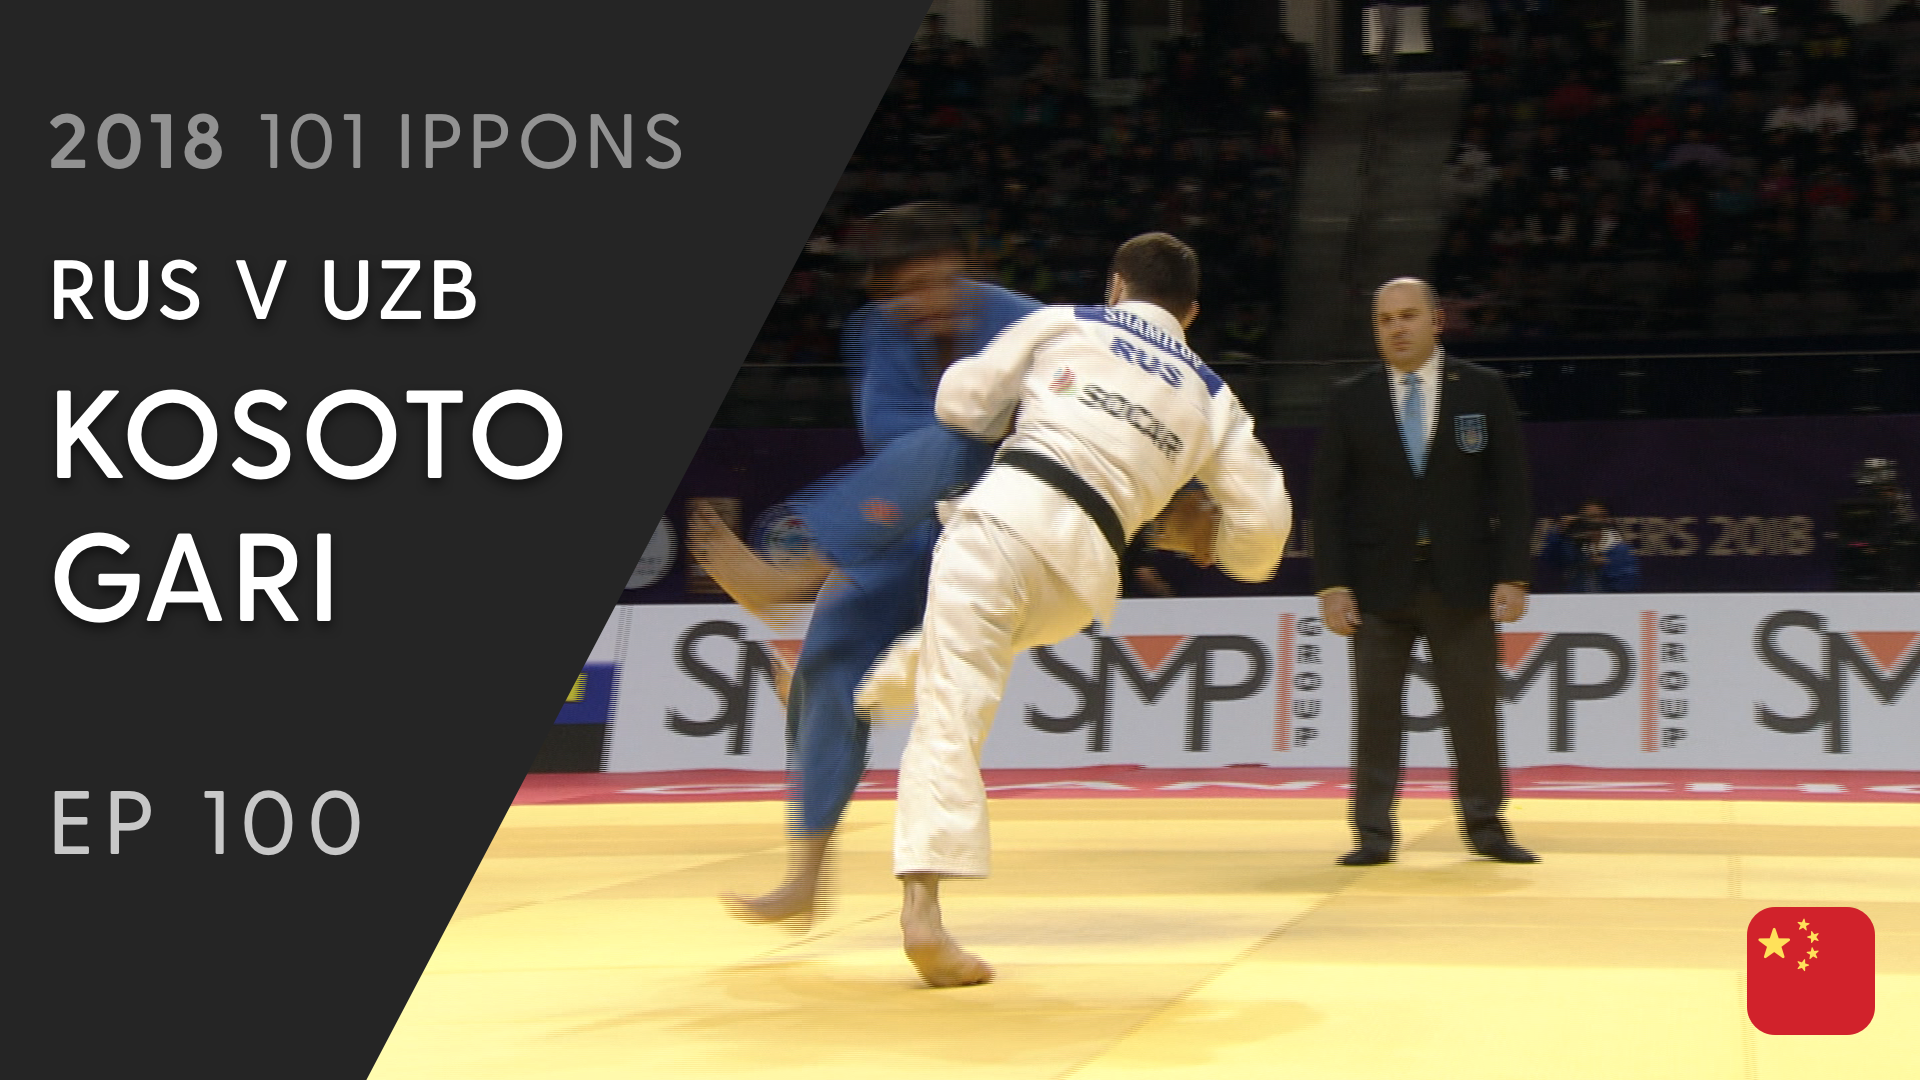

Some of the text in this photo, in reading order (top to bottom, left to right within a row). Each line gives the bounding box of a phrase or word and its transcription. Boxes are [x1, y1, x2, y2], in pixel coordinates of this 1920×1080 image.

[1104, 307, 1203, 370] SHAMILOV
[1110, 336, 1184, 389] RUS
[1079, 385, 1184, 463] SOCAR
[1706, 516, 1816, 557] 2018
[1023, 619, 1274, 752] SMP
[1293, 617, 1322, 747] GROUP
[1658, 614, 1688, 748] GROUP
